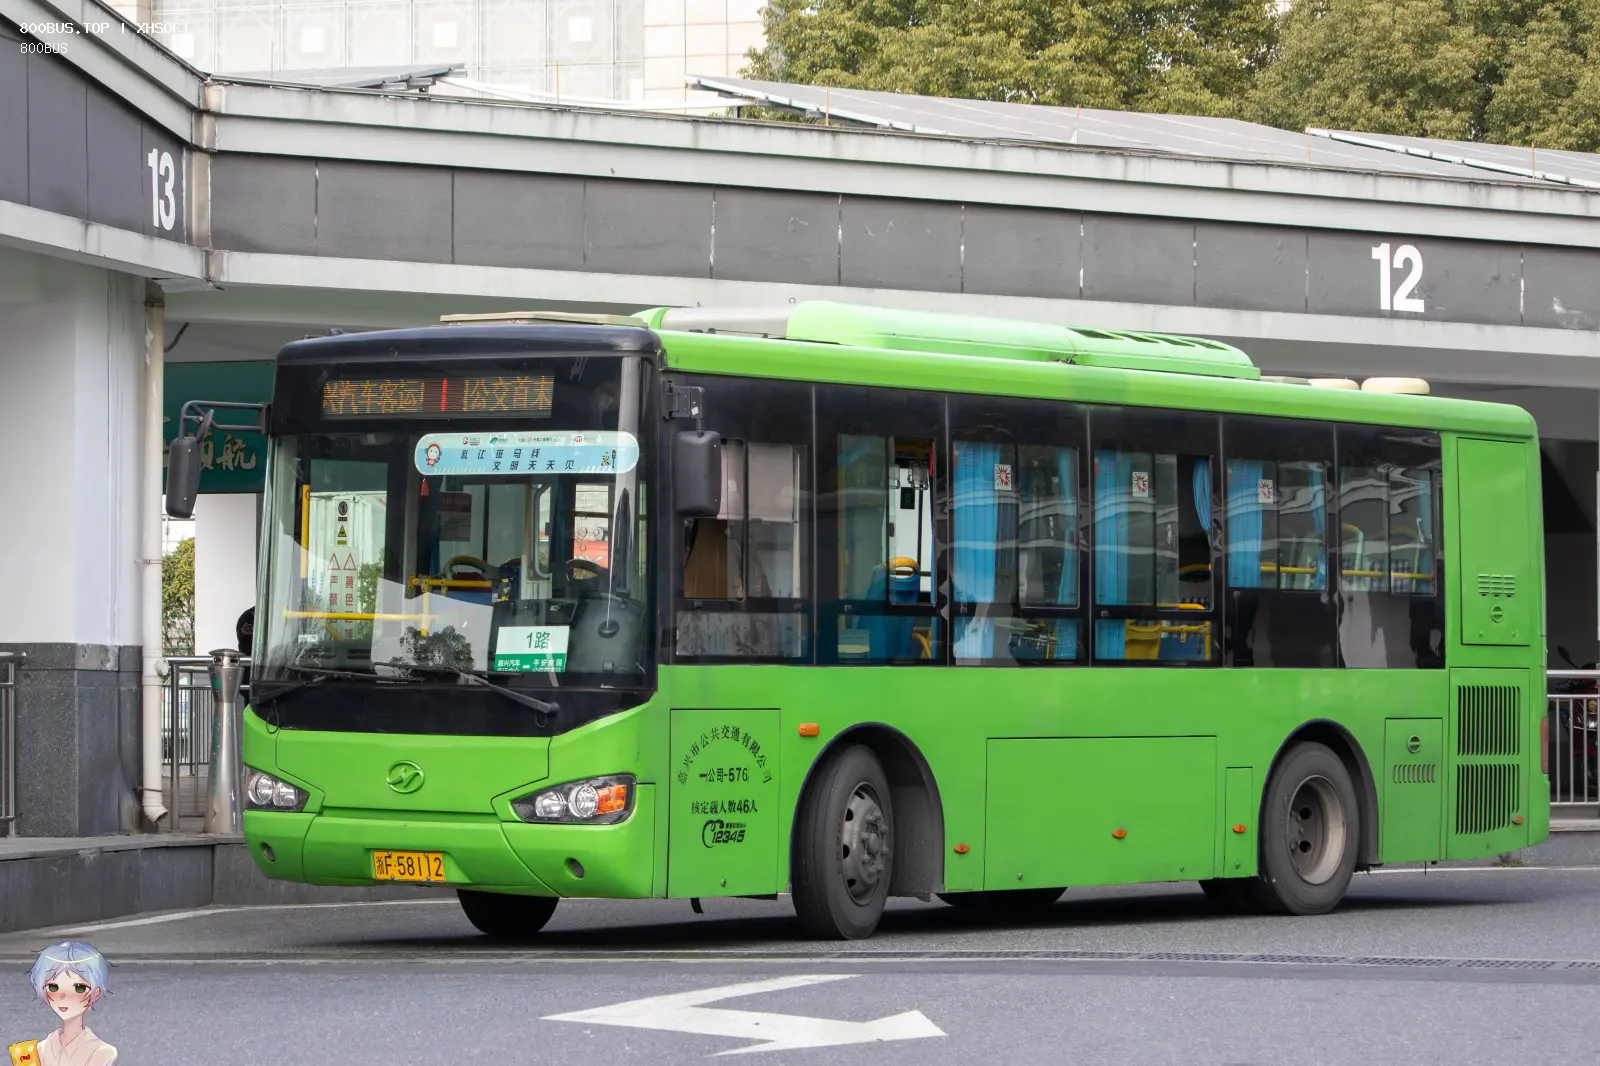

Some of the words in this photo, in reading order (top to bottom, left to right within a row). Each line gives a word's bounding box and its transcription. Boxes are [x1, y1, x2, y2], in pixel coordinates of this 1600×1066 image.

[148, 148, 176, 231] 13
[1371, 242, 1425, 313] 12
[492, 459, 575, 471] 文明天天见
[526, 631, 551, 649] 1路
[677, 724, 772, 786] 嘉兴市公共交通有限公司
[691, 799, 758, 815] 核定载人数46人
[711, 829, 746, 844] 12345
